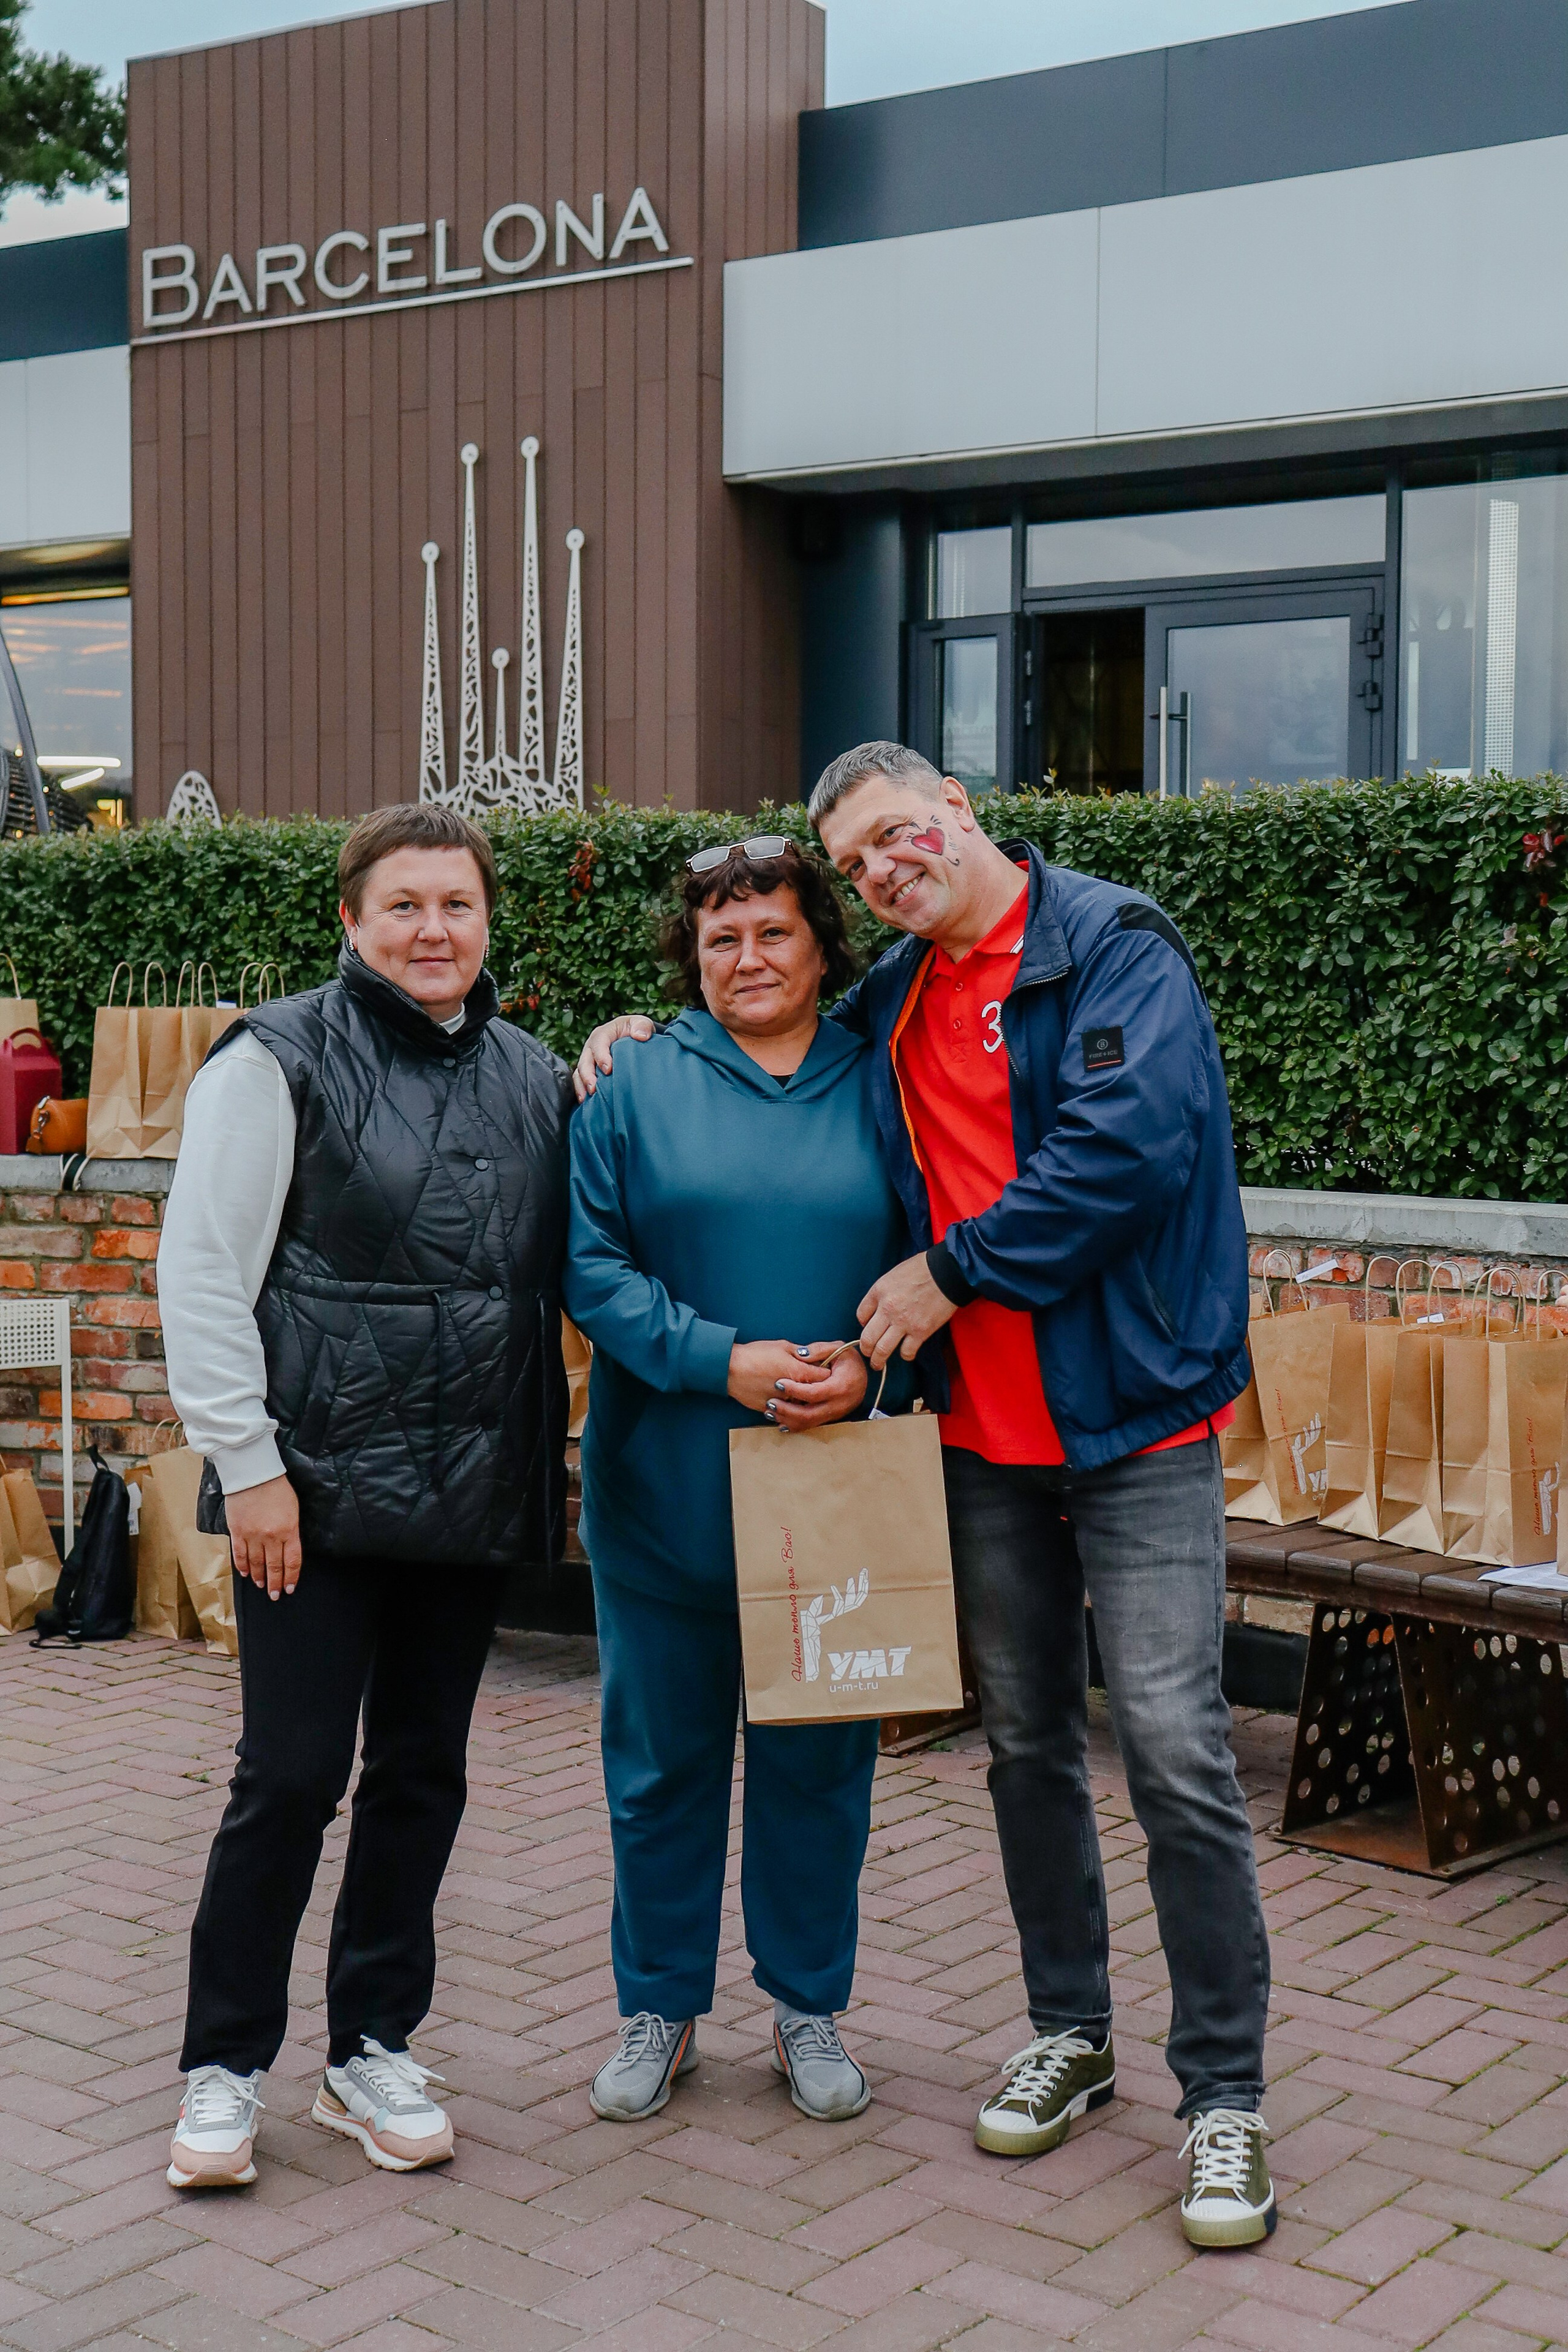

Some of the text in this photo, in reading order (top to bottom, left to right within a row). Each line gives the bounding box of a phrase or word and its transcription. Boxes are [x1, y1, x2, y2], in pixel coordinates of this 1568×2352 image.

[141, 186, 669, 328] BARCELONA
[981, 1000, 1003, 1053] 3
[781, 1526, 794, 1563] Вас!
[789, 1566, 799, 1590] для
[791, 1638, 802, 1682] Наше
[829, 1682, 879, 1694] u-m-t.ru
